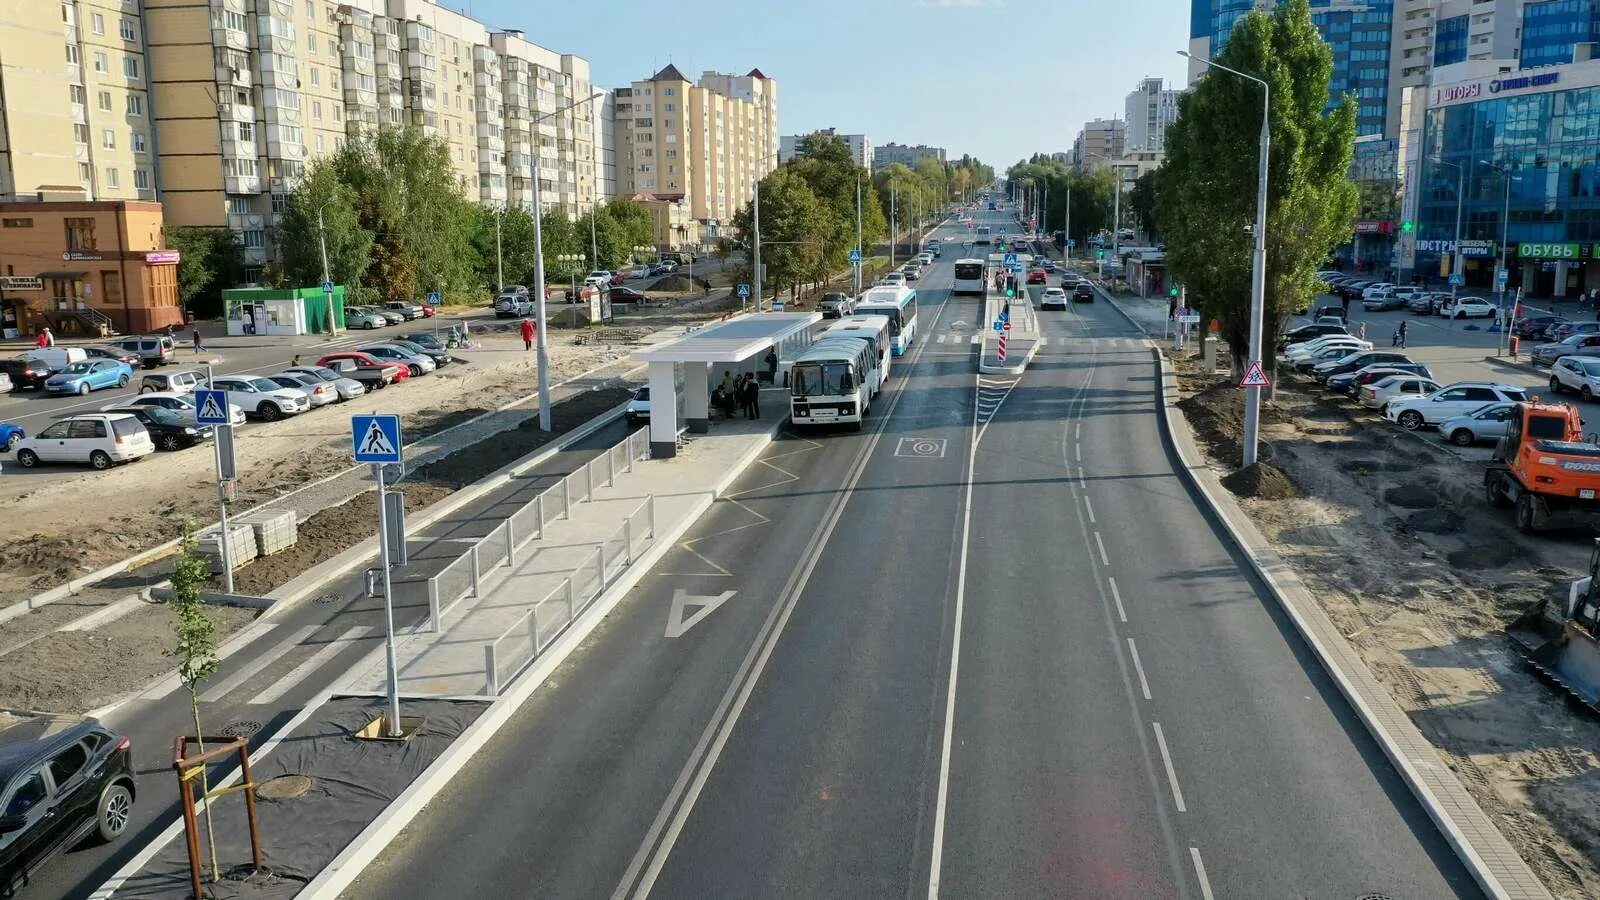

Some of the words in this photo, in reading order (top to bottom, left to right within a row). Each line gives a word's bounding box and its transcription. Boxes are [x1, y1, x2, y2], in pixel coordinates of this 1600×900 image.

[1444, 83, 1480, 102] ШТОРЫ
[1415, 240, 1457, 251] ЛЮСТРЫ
[1462, 247, 1487, 255] ШТОРЫ
[1522, 244, 1573, 257] ОБУВЬ
